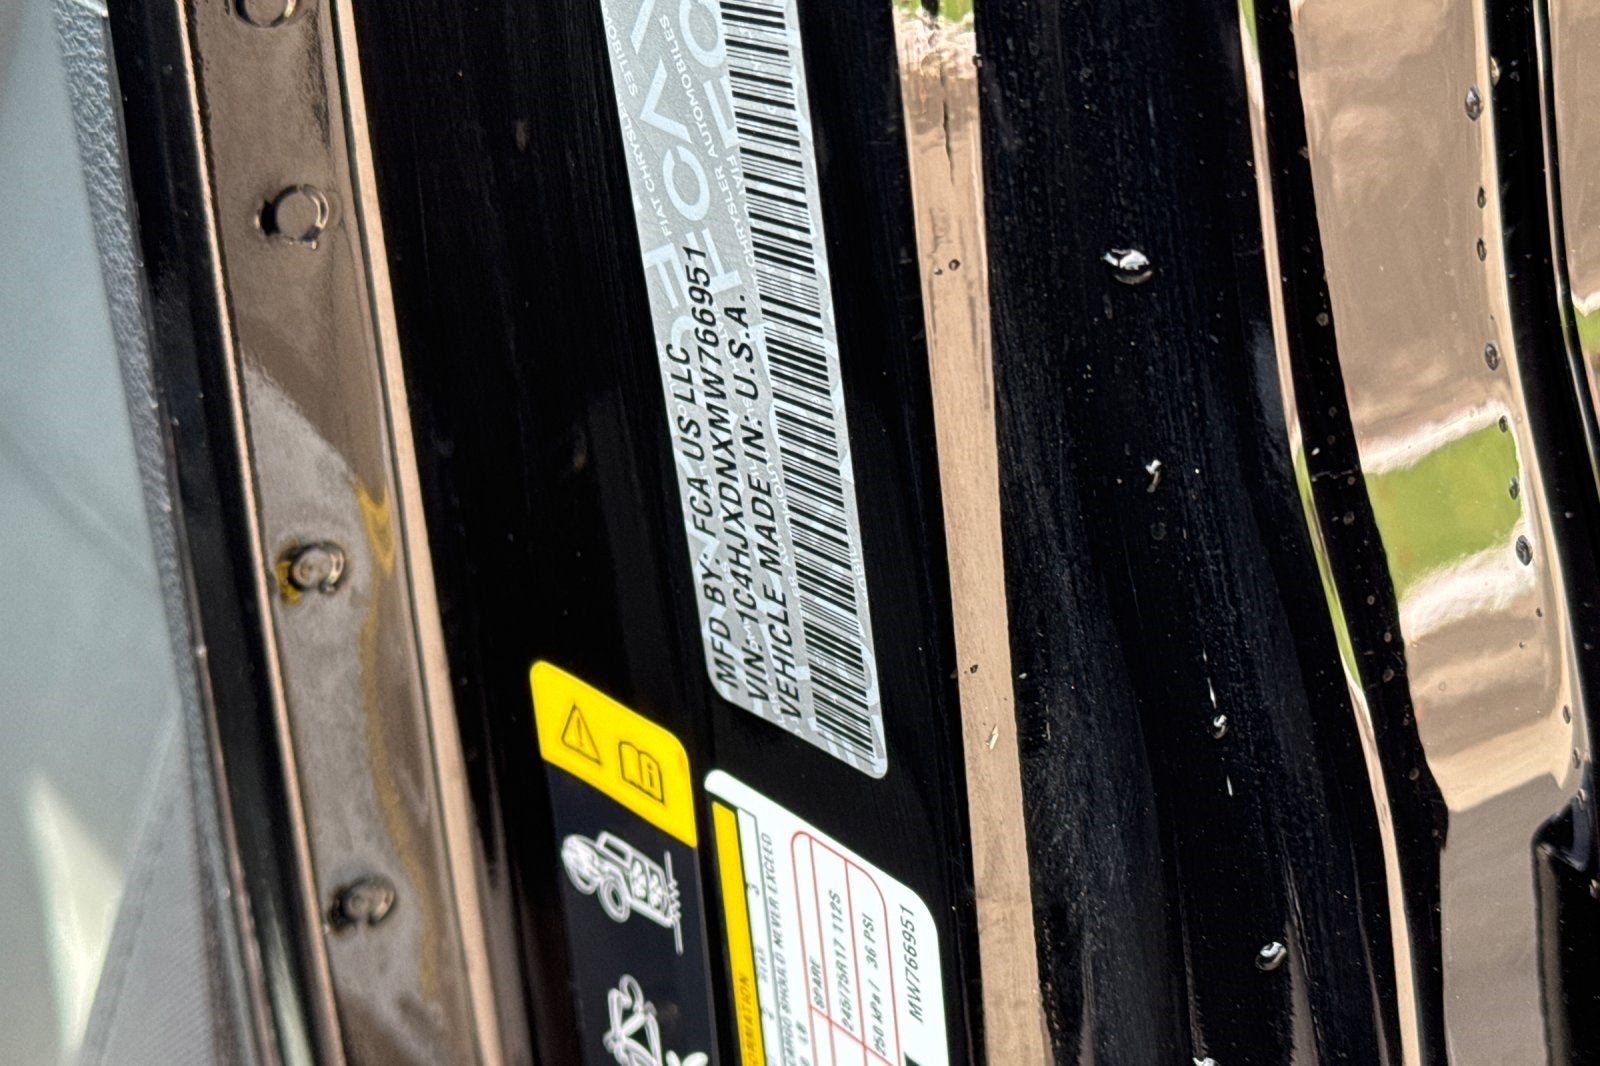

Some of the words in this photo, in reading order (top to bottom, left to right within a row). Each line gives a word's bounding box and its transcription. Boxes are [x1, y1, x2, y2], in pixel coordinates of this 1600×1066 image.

[658, 13, 718, 159] AUTOMOBILES
[665, 343, 697, 405] LLC
[723, 293, 759, 401] U.S.A.
[677, 415, 705, 462] US
[683, 245, 760, 626] 1C4HJXDNXMW766951
[740, 414, 768, 465] IN:
[687, 477, 717, 538] FCA
[747, 473, 784, 577] MADE
[702, 552, 727, 608] BY:
[708, 616, 738, 689] MFD
[745, 645, 770, 702] VIN:
[763, 588, 803, 719] VEHICLE
[761, 832, 779, 894] EXCEED
[768, 896, 785, 950] NEVER
[828, 889, 845, 934] 112S
[861, 913, 879, 944] PSI
[809, 955, 825, 1009] SPARE
[834, 937, 855, 1033] 245/75R17
[899, 902, 925, 1024] MW766951
